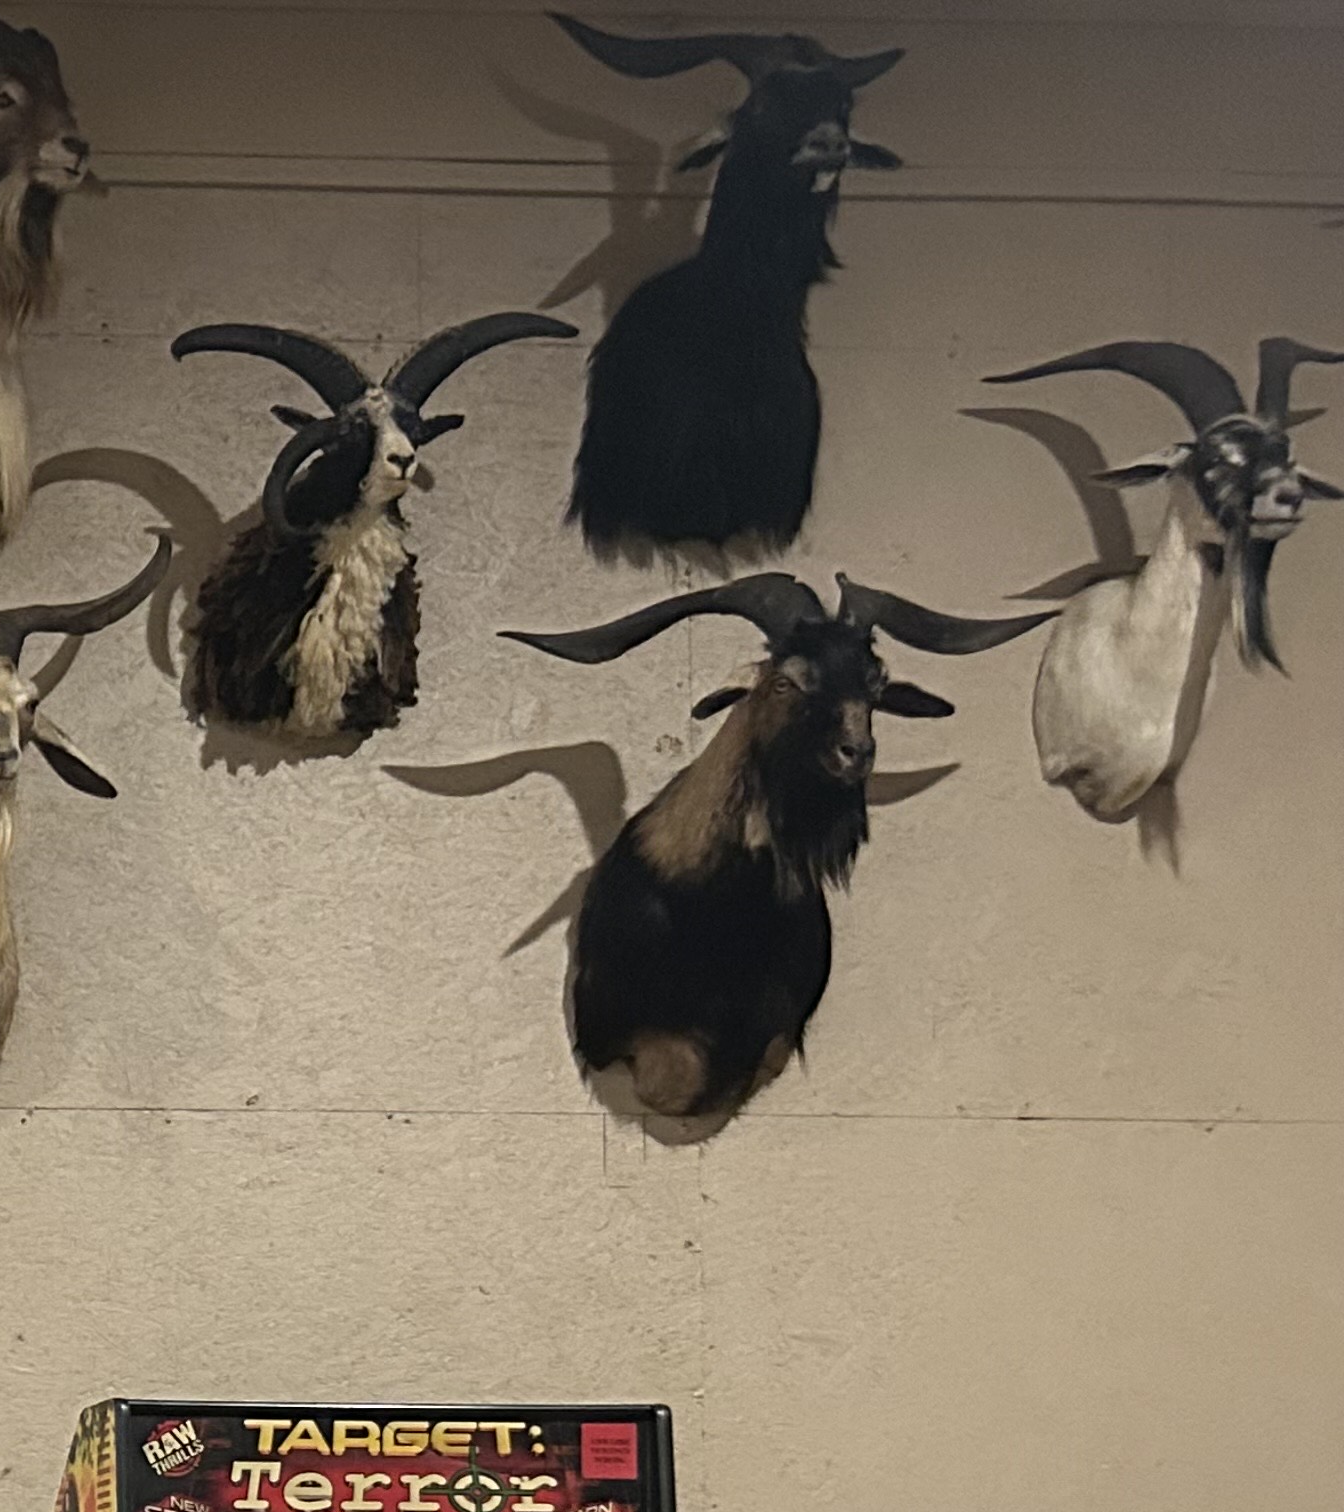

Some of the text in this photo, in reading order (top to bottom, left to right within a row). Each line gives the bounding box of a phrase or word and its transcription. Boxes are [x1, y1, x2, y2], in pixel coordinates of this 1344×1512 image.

[142, 1420, 197, 1465] RAW
[152, 1439, 205, 1476] THRILLS
[244, 1420, 545, 1456] TARGET:
[231, 1461, 558, 1512] Terror
